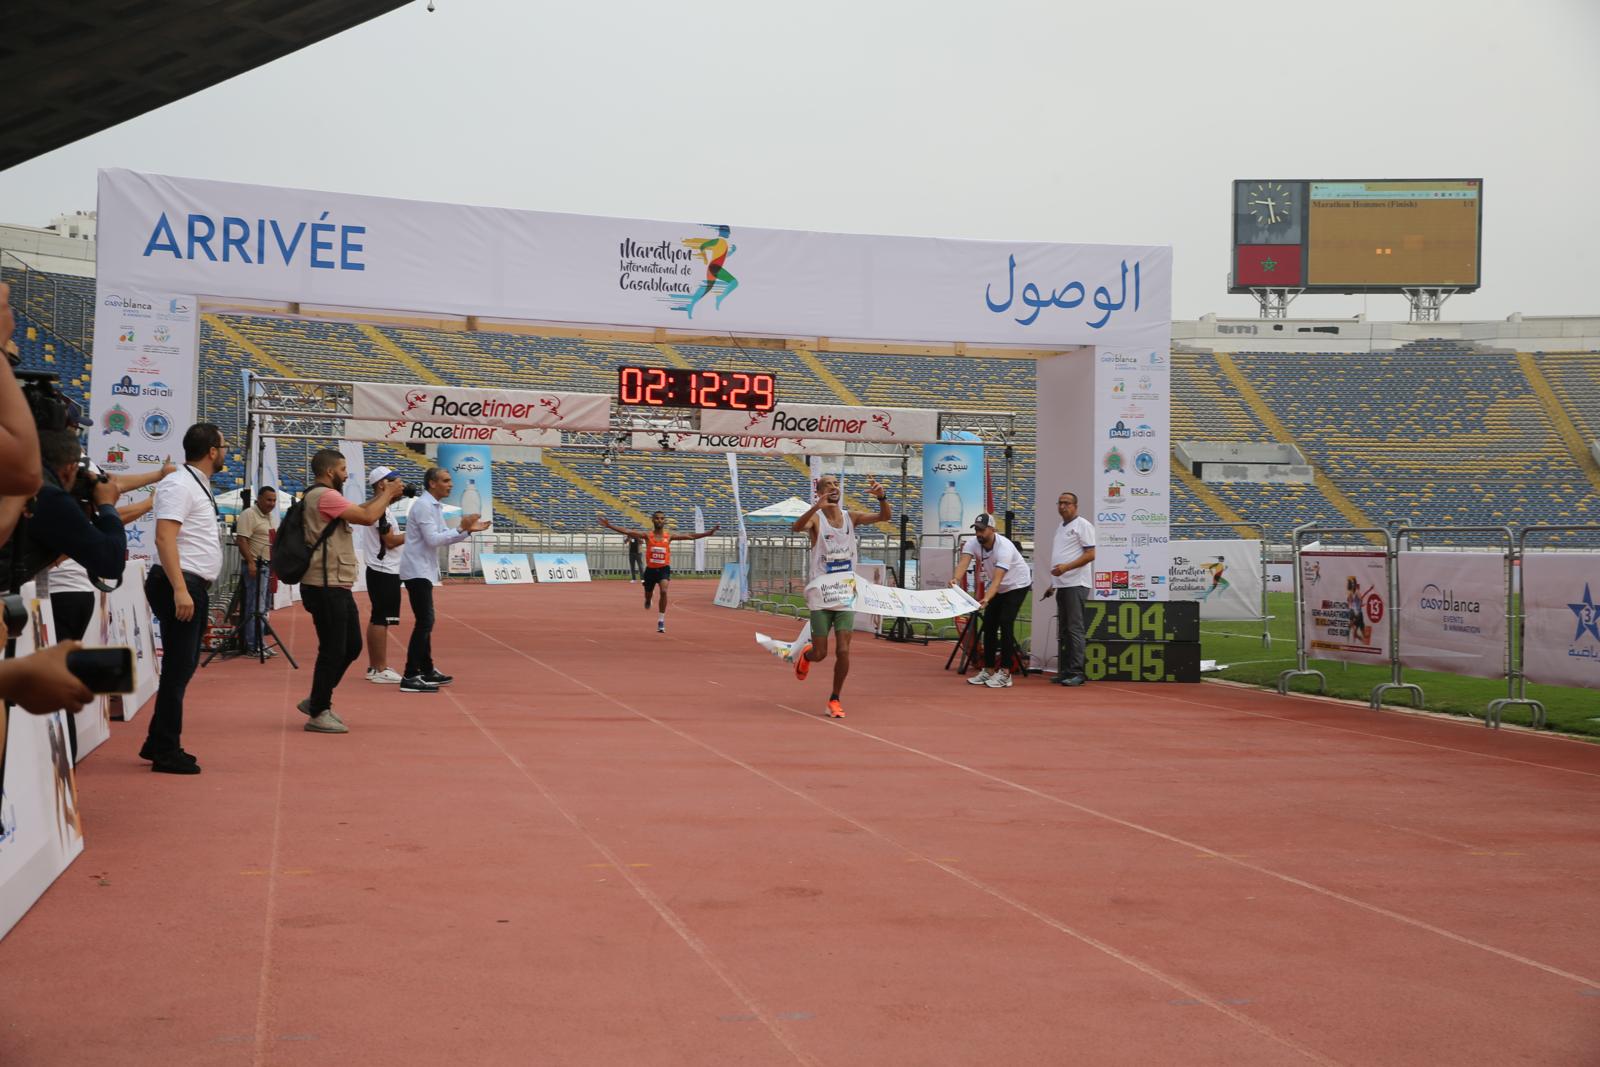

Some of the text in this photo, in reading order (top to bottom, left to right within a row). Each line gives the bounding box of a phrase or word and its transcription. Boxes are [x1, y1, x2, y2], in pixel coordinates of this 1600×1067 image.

[143, 211, 367, 271] ARRIVÉE
[620, 237, 693, 263] Marathon
[620, 260, 692, 276] International de
[620, 272, 691, 294] Casablanca
[985, 253, 1140, 329] الوصول
[113, 385, 139, 395] DARI
[621, 367, 773, 410] 02:12:29
[431, 394, 535, 418] Racetimer
[410, 421, 497, 440] Racetimer
[771, 410, 867, 434] Racetimer
[698, 433, 779, 449] Racetimer
[137, 454, 160, 462] ESCA
[494, 567, 522, 580] sidi ali
[548, 567, 578, 580] sidi ali
